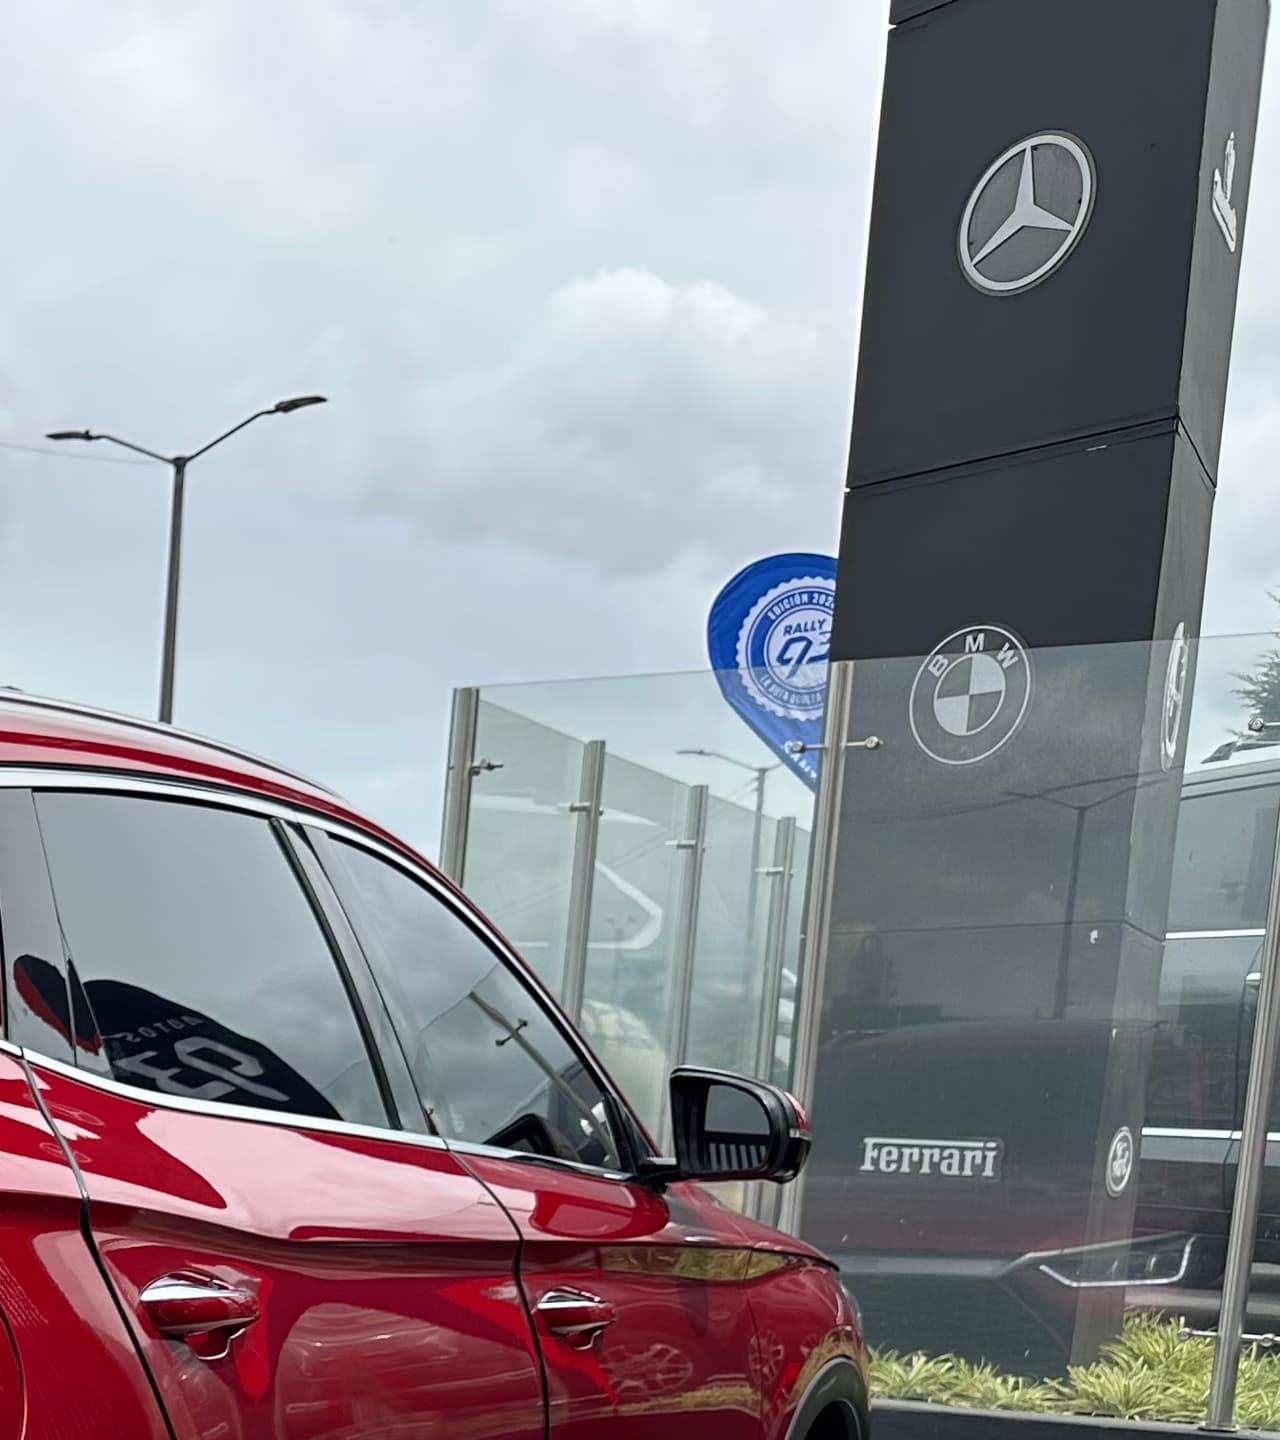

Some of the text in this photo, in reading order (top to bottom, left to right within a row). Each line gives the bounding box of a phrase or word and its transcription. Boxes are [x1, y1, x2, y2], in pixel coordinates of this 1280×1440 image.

[811, 592, 835, 608] 202
[783, 619, 827, 637] RALLY
[927, 632, 1019, 678] BMW
[859, 1137, 998, 1177] Ferrari
